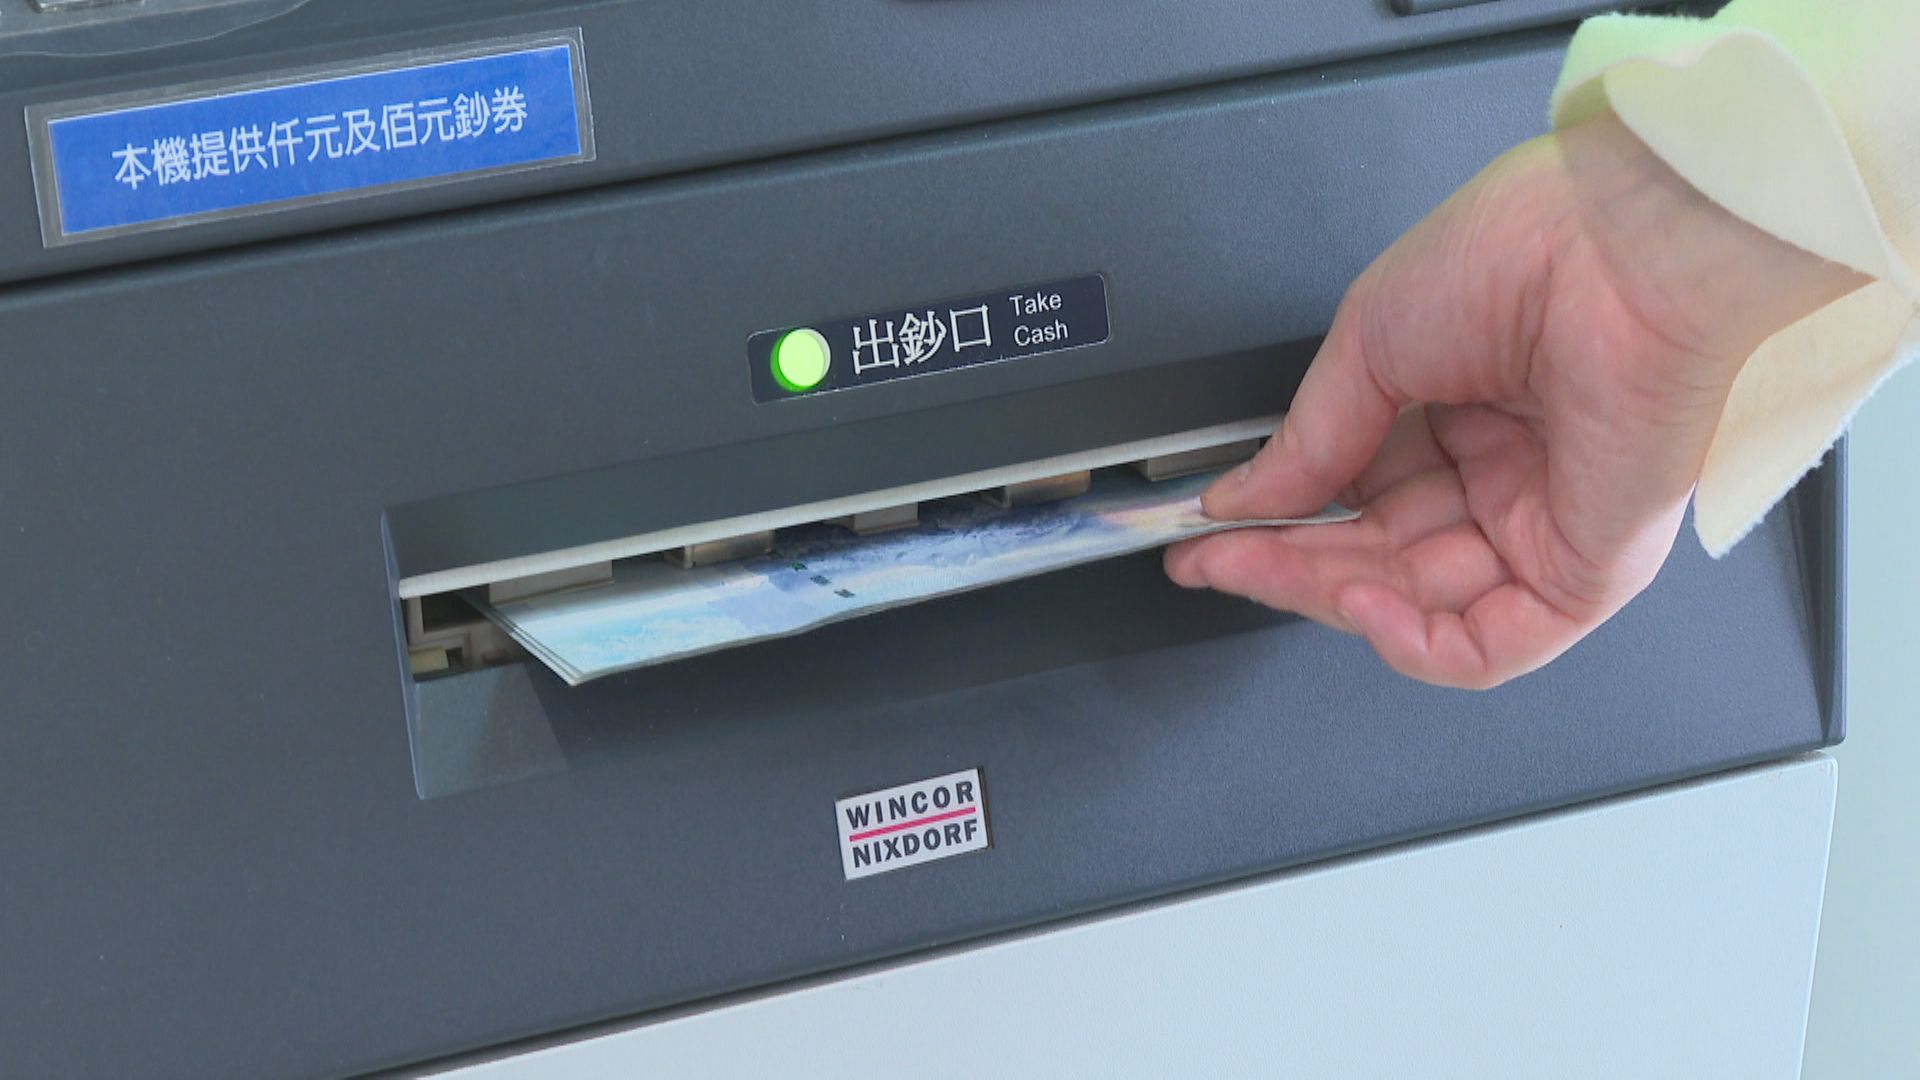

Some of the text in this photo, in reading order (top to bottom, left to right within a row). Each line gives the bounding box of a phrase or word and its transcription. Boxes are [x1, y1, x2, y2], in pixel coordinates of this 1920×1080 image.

[112, 86, 527, 189] 本機提供仟元及佰元鈔券
[1009, 292, 1062, 317] Take
[852, 304, 992, 374] 出鈔口
[1014, 319, 1069, 346] Cash
[846, 781, 974, 830] WINCOR
[852, 819, 977, 868] NIXDORF
